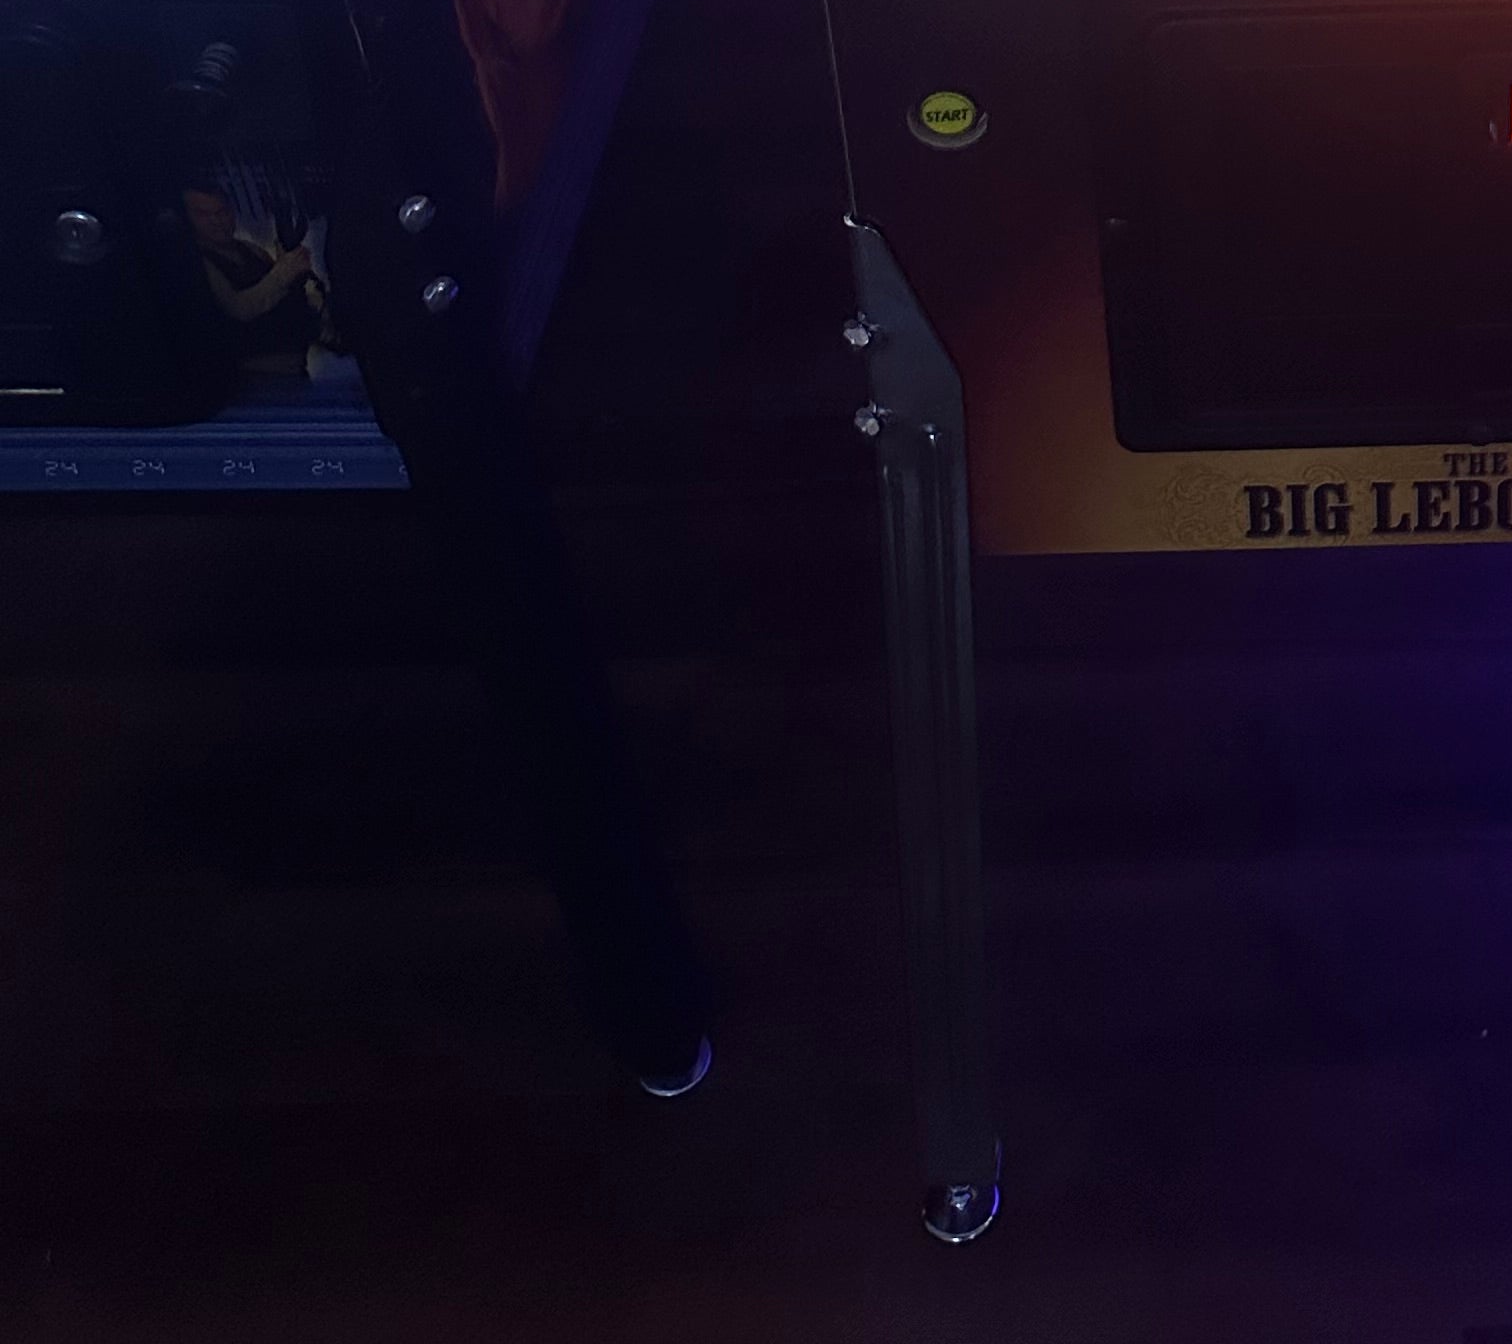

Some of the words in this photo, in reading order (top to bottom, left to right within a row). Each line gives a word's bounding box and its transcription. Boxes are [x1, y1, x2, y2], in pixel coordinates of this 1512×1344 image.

[925, 108, 969, 123] START
[1444, 451, 1509, 477] THE
[1244, 481, 1354, 538] BIG
